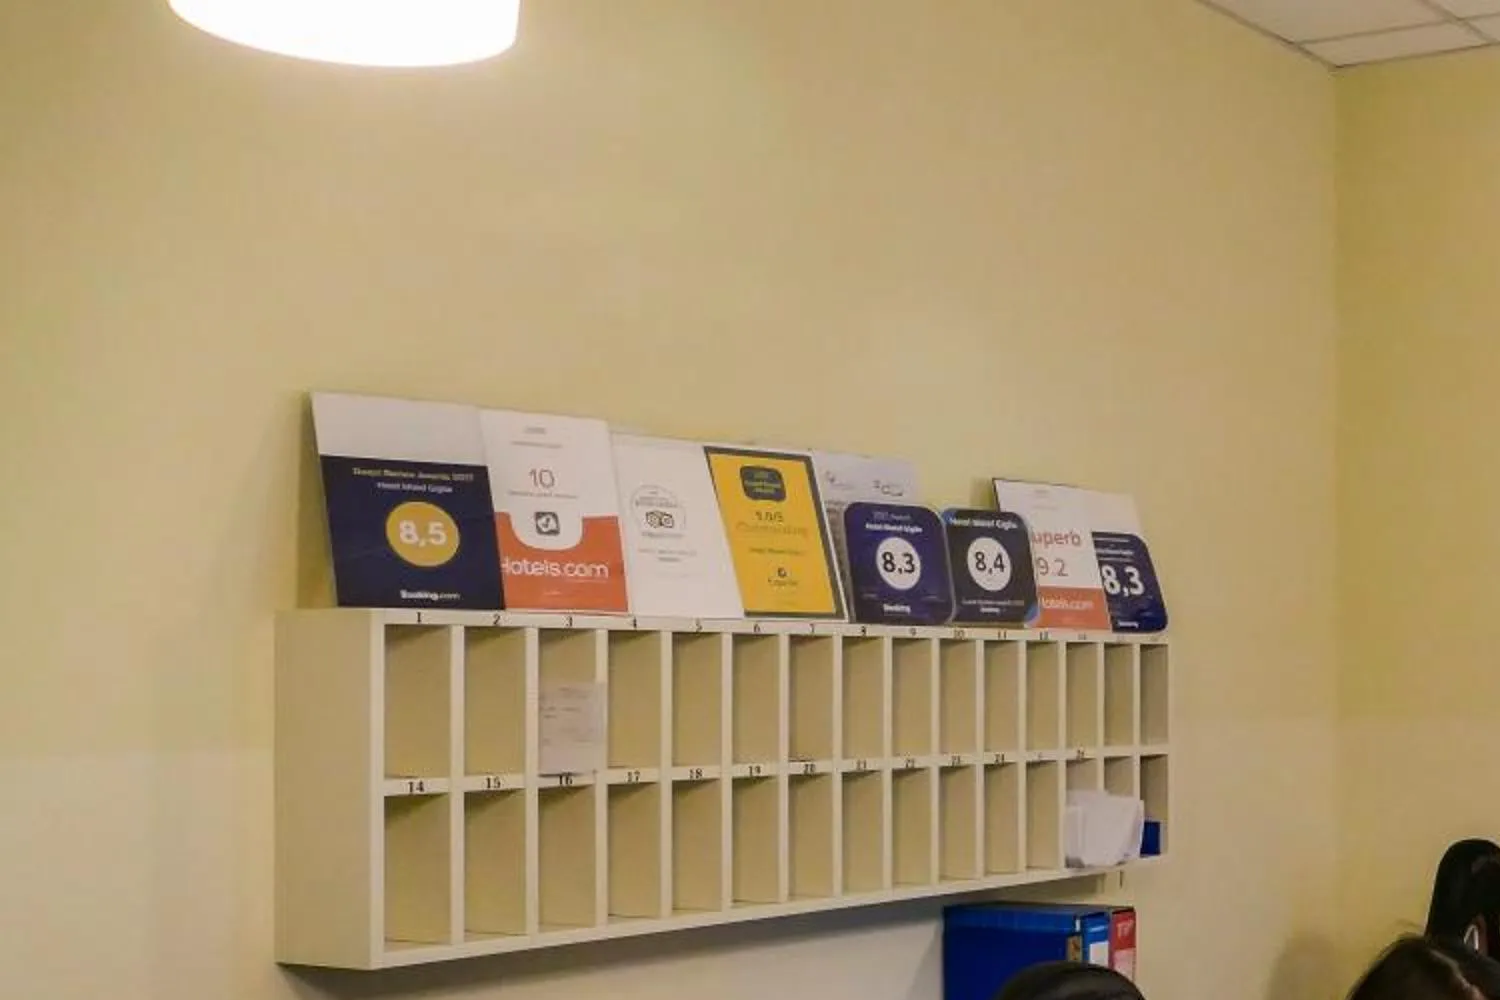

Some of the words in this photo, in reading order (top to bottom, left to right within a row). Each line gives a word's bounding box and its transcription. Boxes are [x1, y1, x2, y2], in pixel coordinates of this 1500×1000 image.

[529, 468, 556, 489] 10
[399, 520, 448, 547] 8,5
[1032, 527, 1081, 548] uperb
